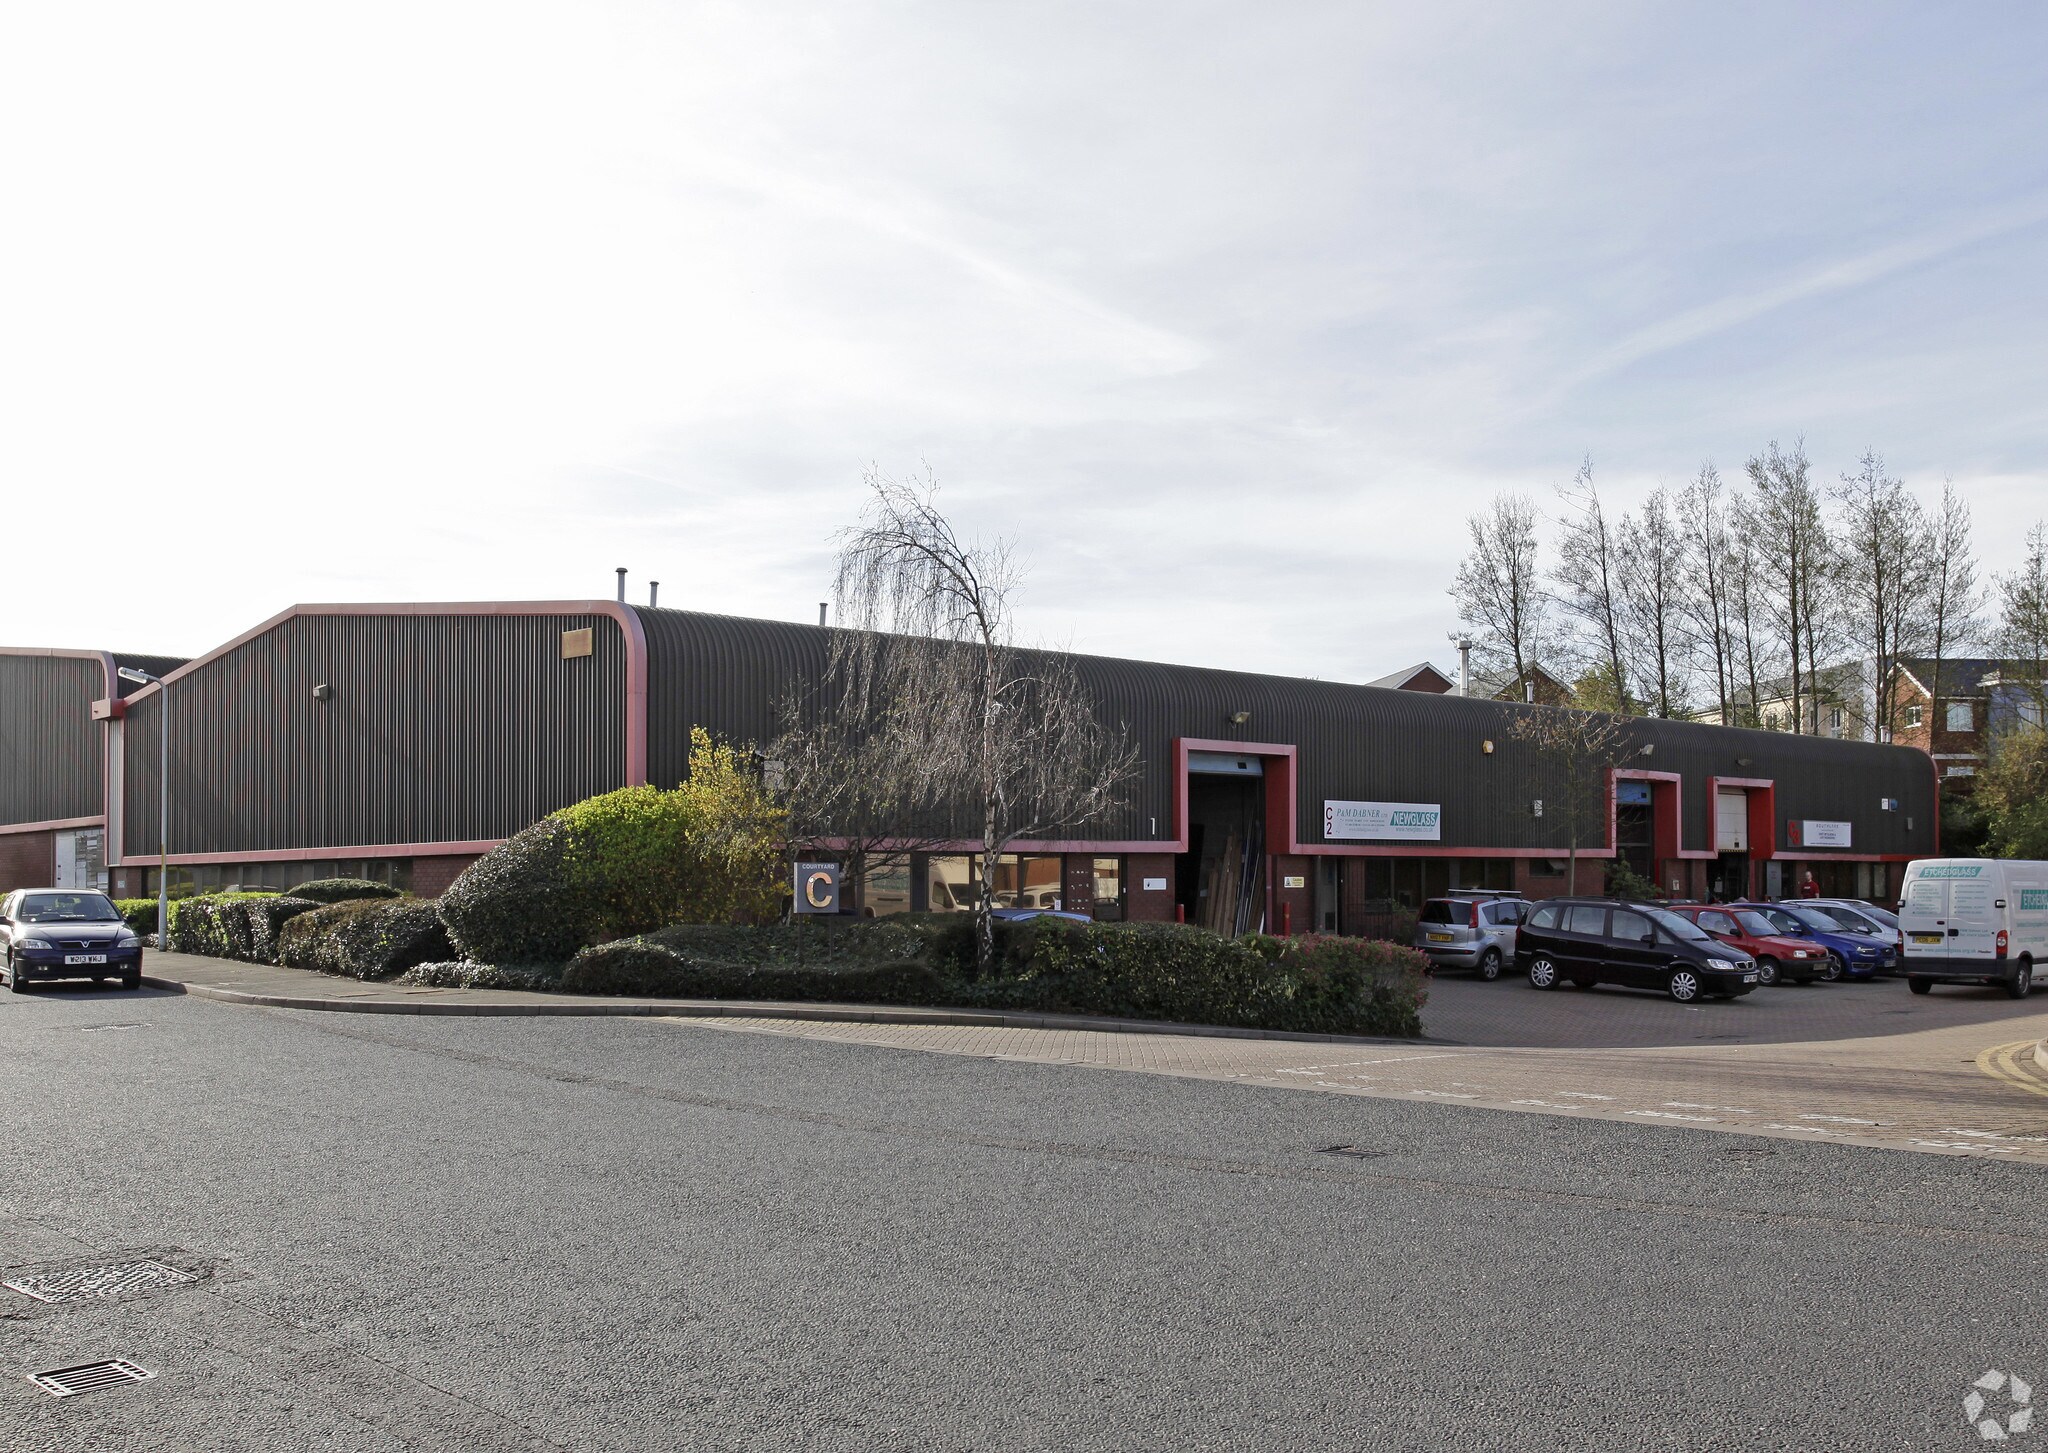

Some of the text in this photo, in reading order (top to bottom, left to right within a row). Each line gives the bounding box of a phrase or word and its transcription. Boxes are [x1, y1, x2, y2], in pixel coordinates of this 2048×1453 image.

[1326, 807, 1333, 820] C
[1352, 809, 1380, 818] DABNER
[1393, 811, 1437, 826] NEWGLASS
[1326, 821, 1333, 835] 2
[1923, 867, 1977, 876] ETCHEDGLASS
[806, 871, 833, 908] C
